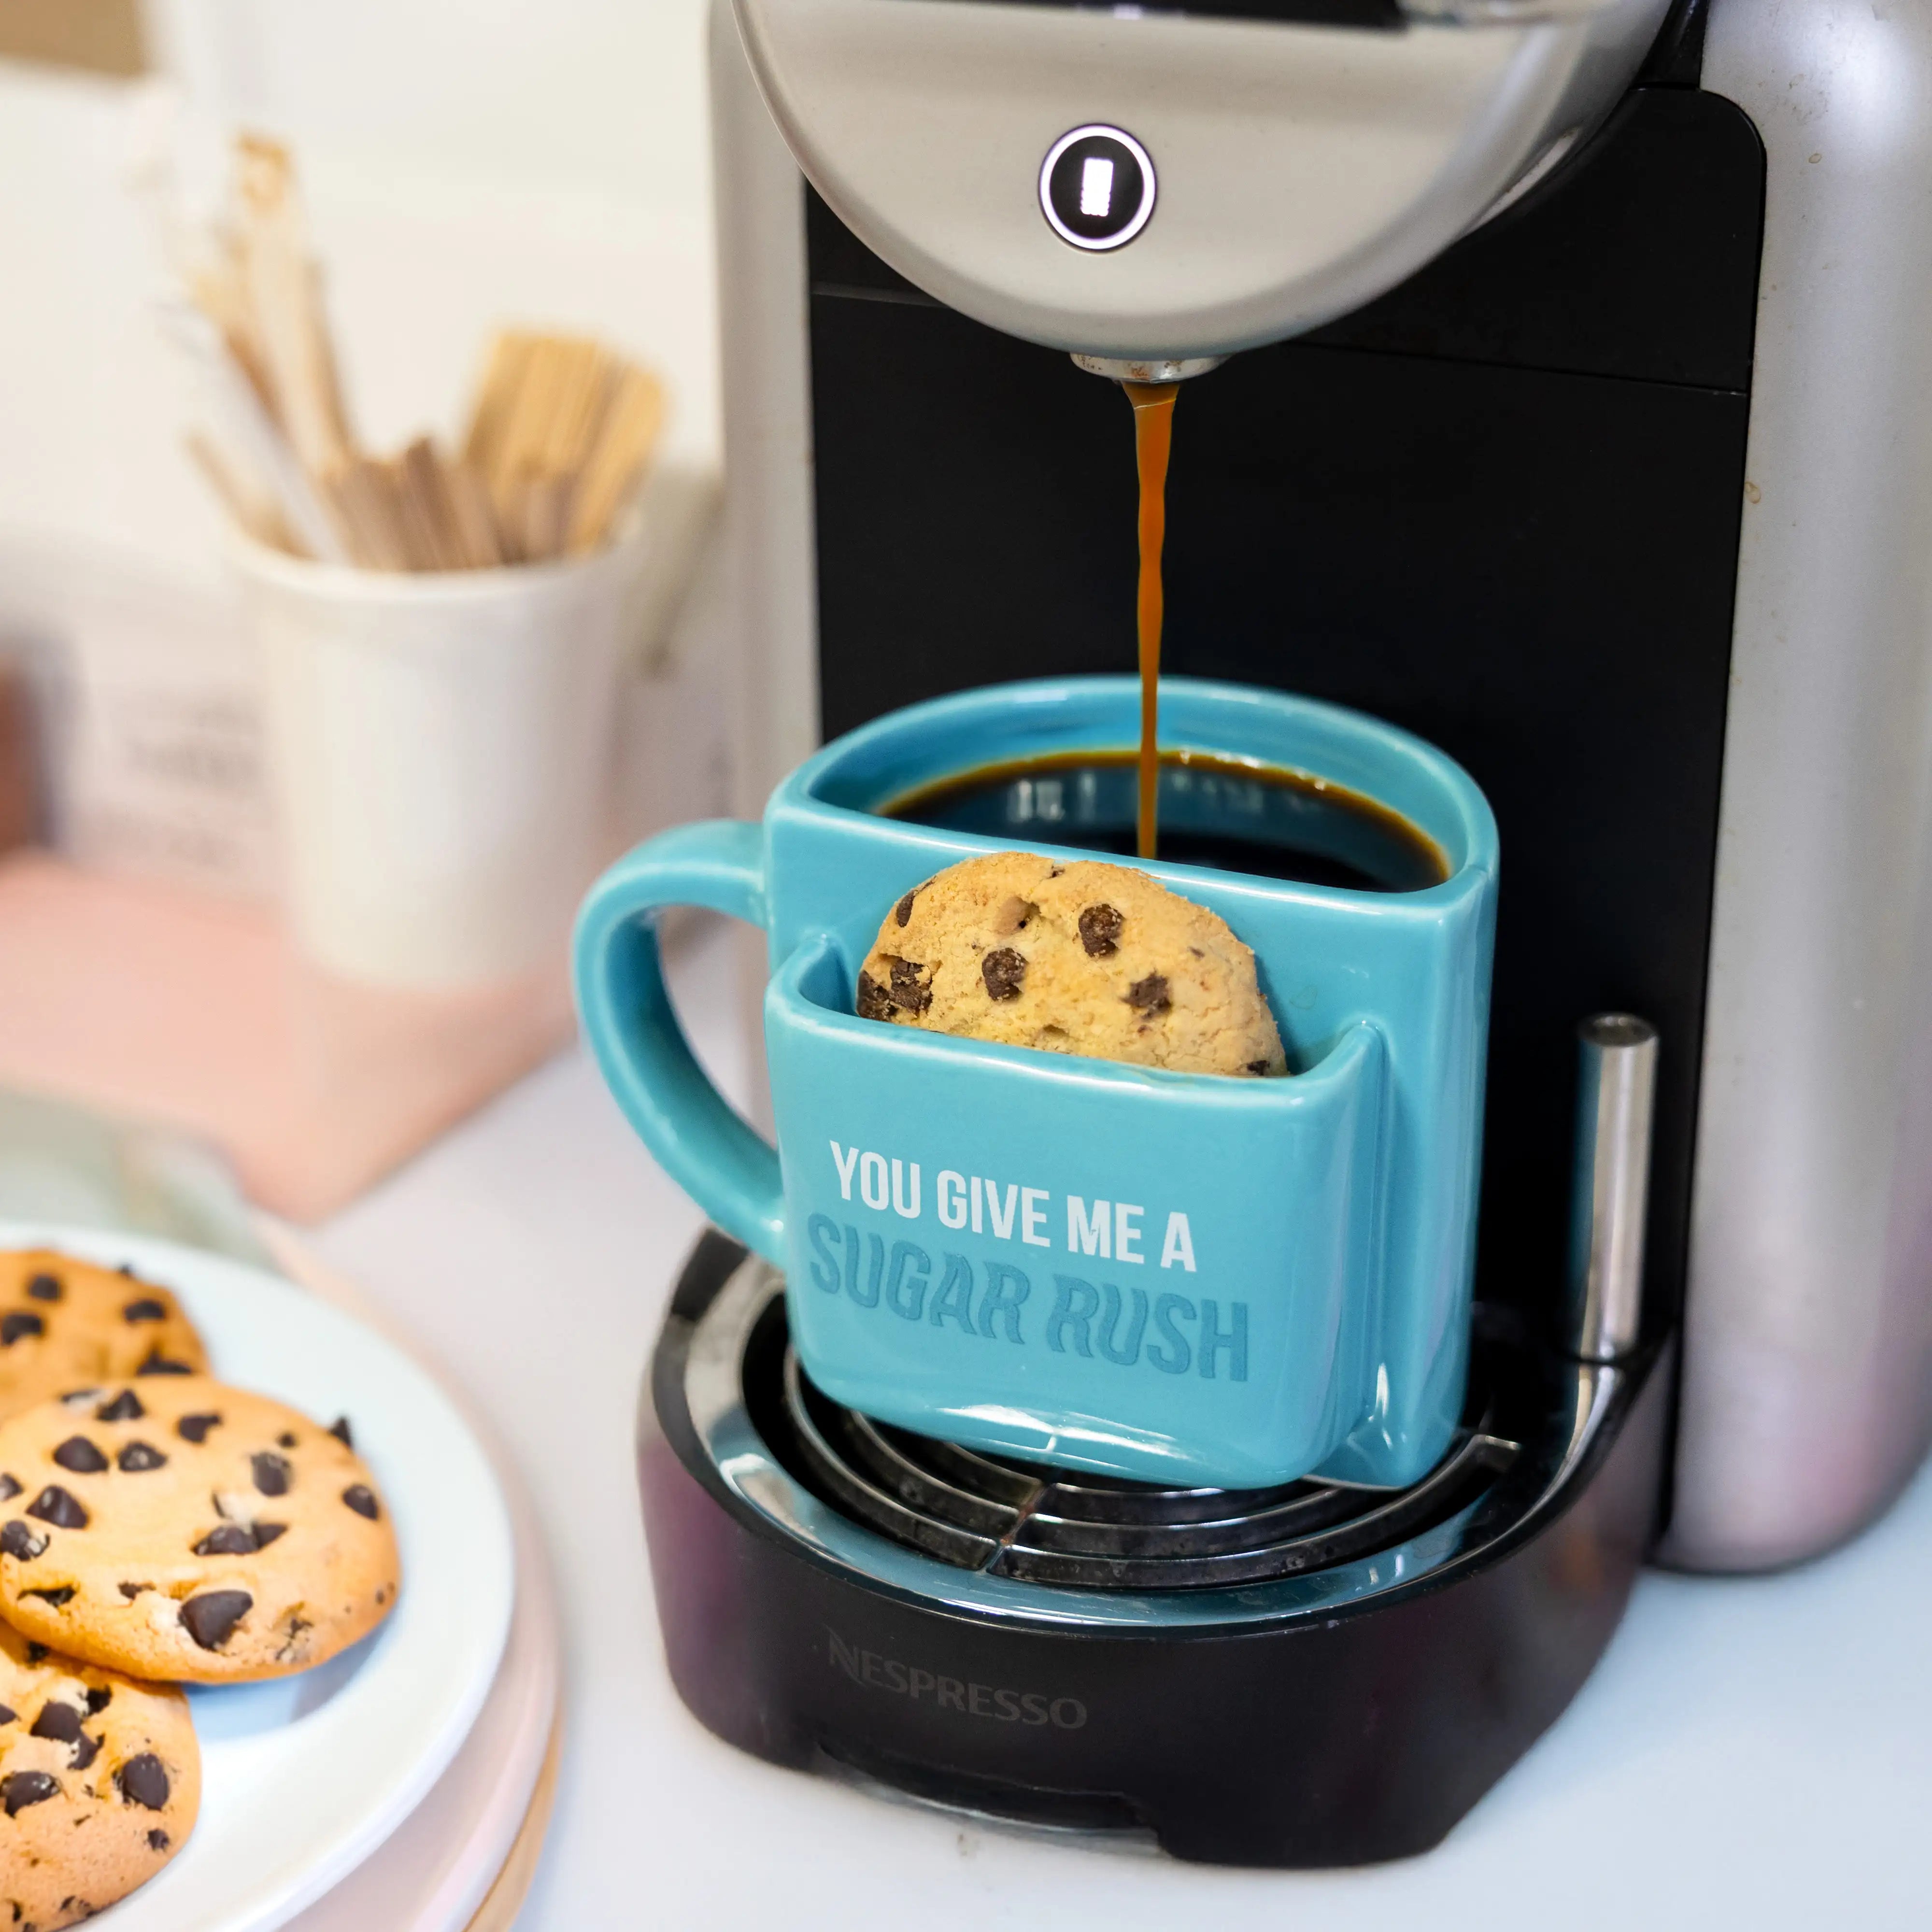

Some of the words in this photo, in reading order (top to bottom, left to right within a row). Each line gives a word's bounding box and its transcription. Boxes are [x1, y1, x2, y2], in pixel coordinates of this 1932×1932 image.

[830, 1140, 921, 1218] YOU
[937, 1169, 1050, 1247] GIVE
[1067, 1195, 1144, 1264] ME
[1160, 1212, 1197, 1272] A
[807, 1213, 1030, 1345] SUGAR
[1047, 1273, 1248, 1382] RUSH
[823, 1622, 1088, 1729] NESPRESSO
